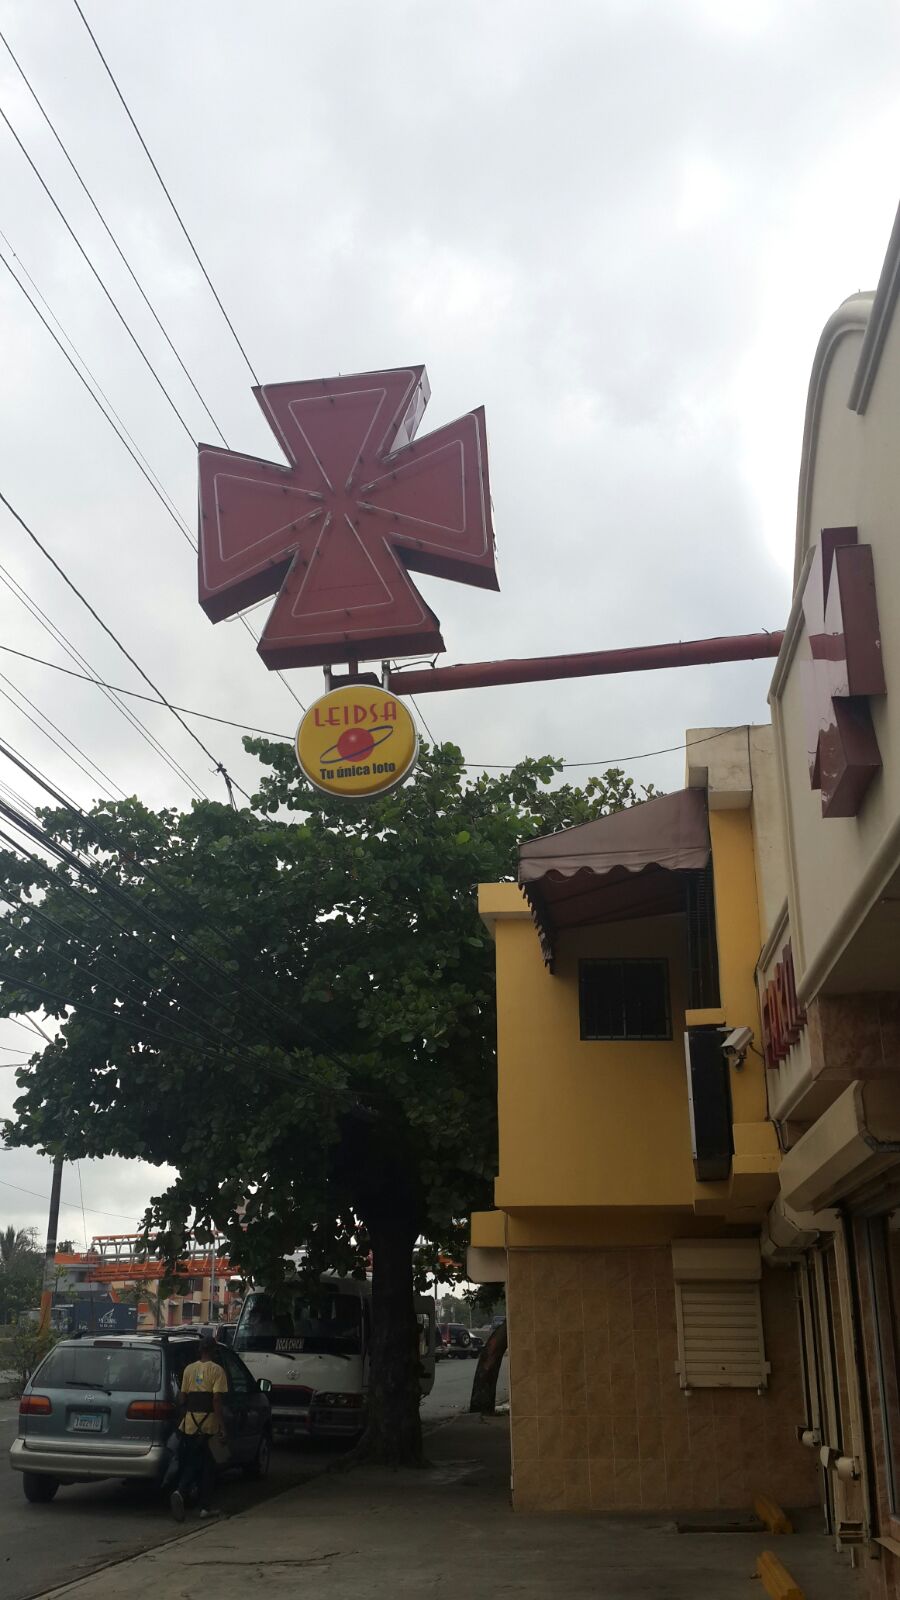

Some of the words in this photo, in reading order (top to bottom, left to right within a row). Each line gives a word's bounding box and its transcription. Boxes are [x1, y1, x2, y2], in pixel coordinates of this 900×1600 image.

[313, 701, 397, 727] LEIDSA
[319, 768, 335, 780] Tu
[336, 765, 371, 778] única
[372, 762, 396, 774] loto
